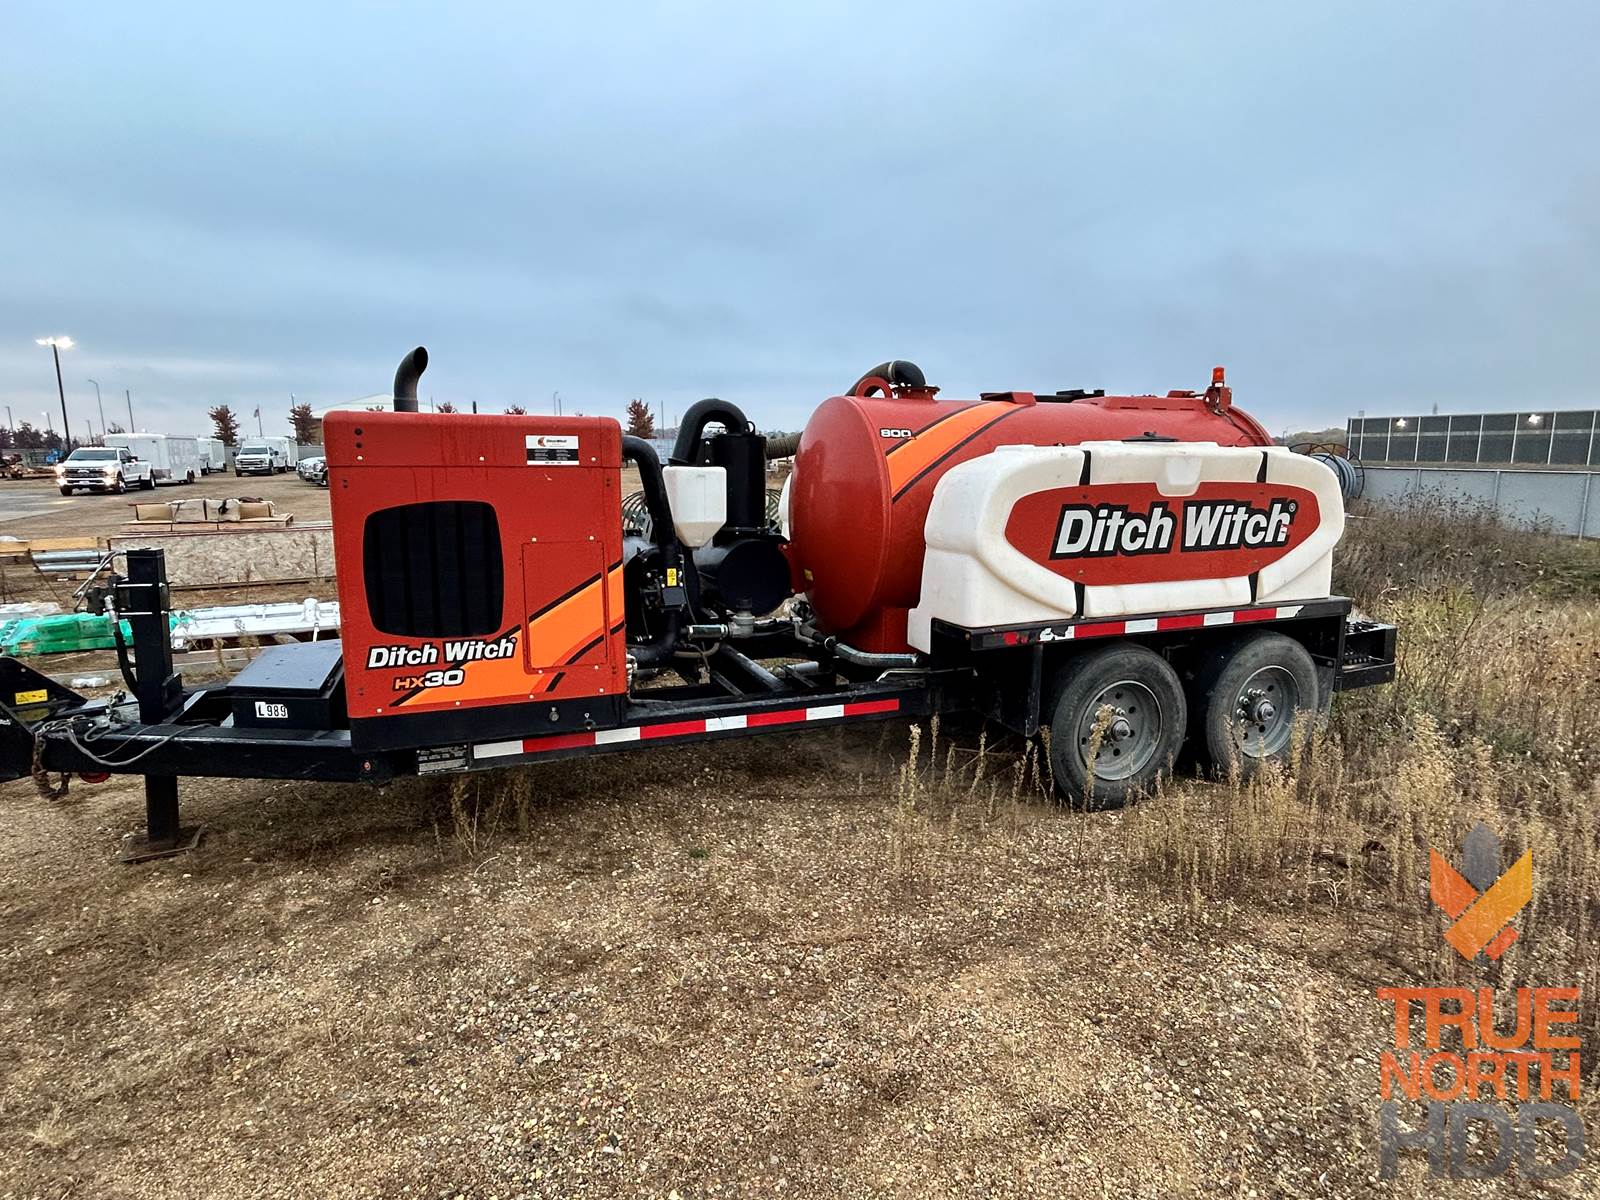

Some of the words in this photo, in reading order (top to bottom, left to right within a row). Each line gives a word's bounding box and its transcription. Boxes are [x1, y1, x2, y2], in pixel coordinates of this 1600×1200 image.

[880, 429, 912, 438] 800
[1056, 507, 1174, 554] Ditch
[1185, 503, 1291, 547] Witch
[368, 644, 438, 668] Ditch
[445, 638, 515, 662] Witch
[395, 669, 464, 690] HX30
